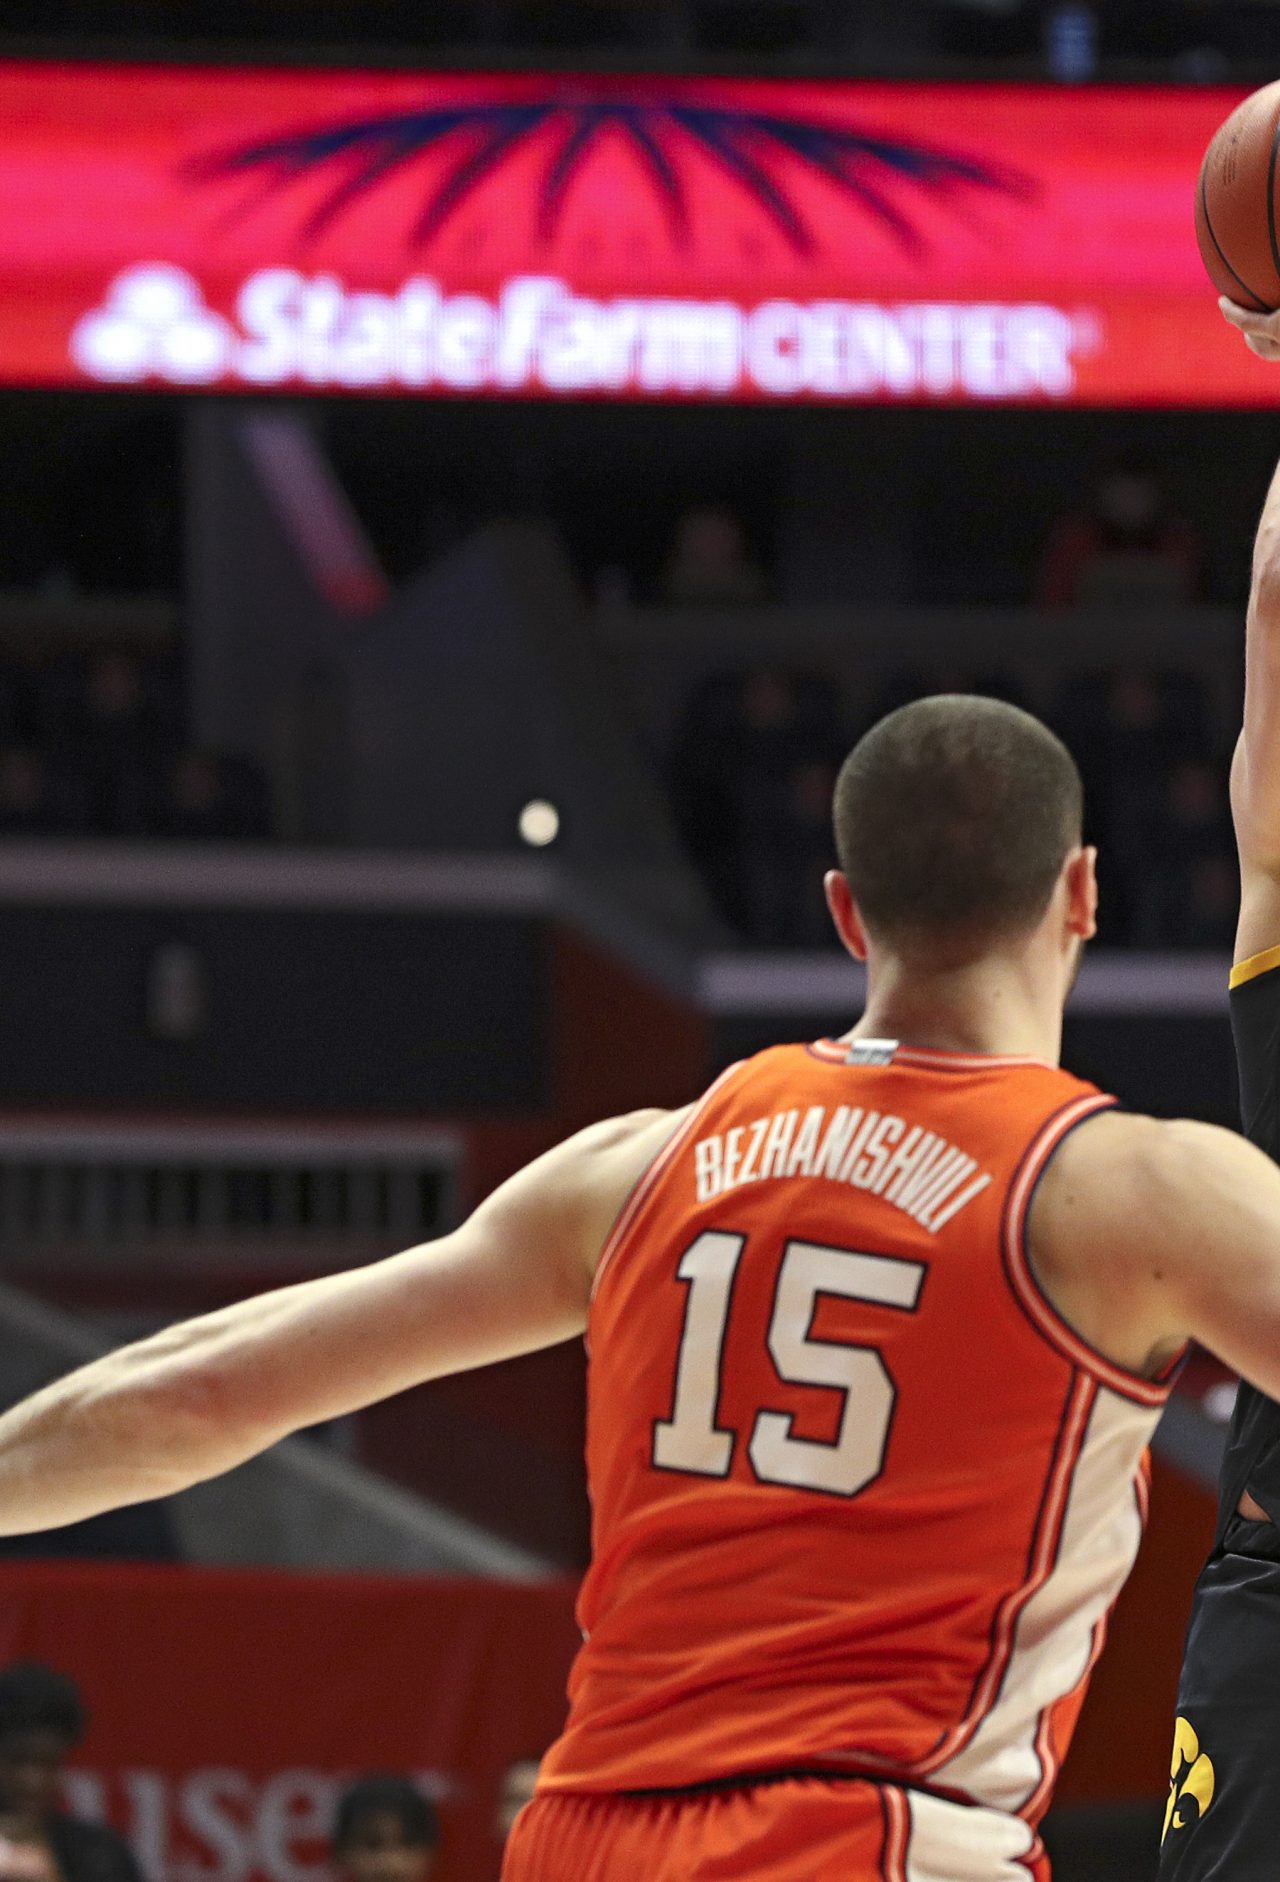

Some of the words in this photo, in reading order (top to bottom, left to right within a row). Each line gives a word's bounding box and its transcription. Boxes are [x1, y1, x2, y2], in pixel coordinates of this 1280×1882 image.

[746, 298, 1076, 396] CENTER
[694, 1105, 993, 1233] BEZHANISHVILI
[651, 1229, 929, 1498] 15
